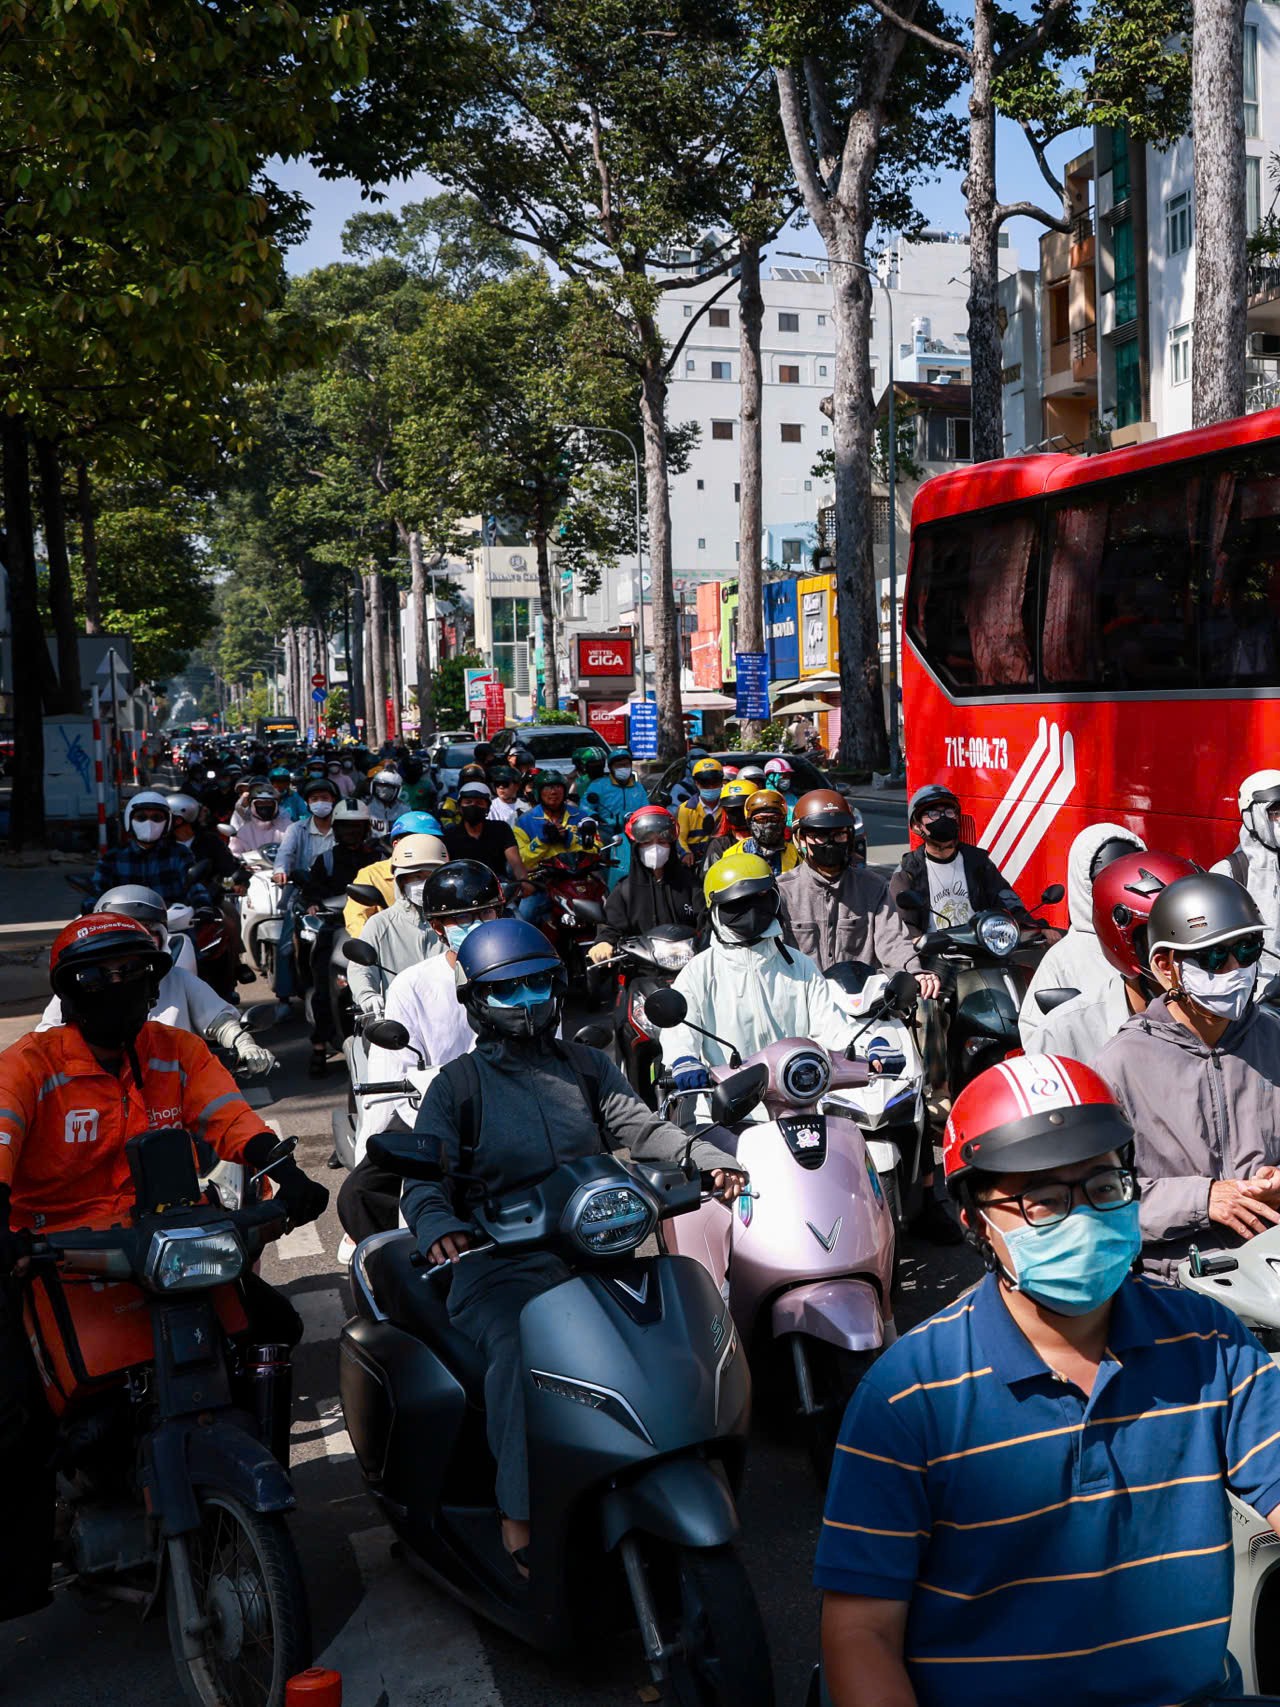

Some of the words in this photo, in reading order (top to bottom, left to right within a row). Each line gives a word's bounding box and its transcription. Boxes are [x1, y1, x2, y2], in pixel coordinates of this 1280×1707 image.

[588, 656, 624, 666] GIGA
[591, 713, 616, 721] GIGA
[944, 736, 1008, 769] 71E-004.73
[787, 1123, 820, 1132] VINFAST
